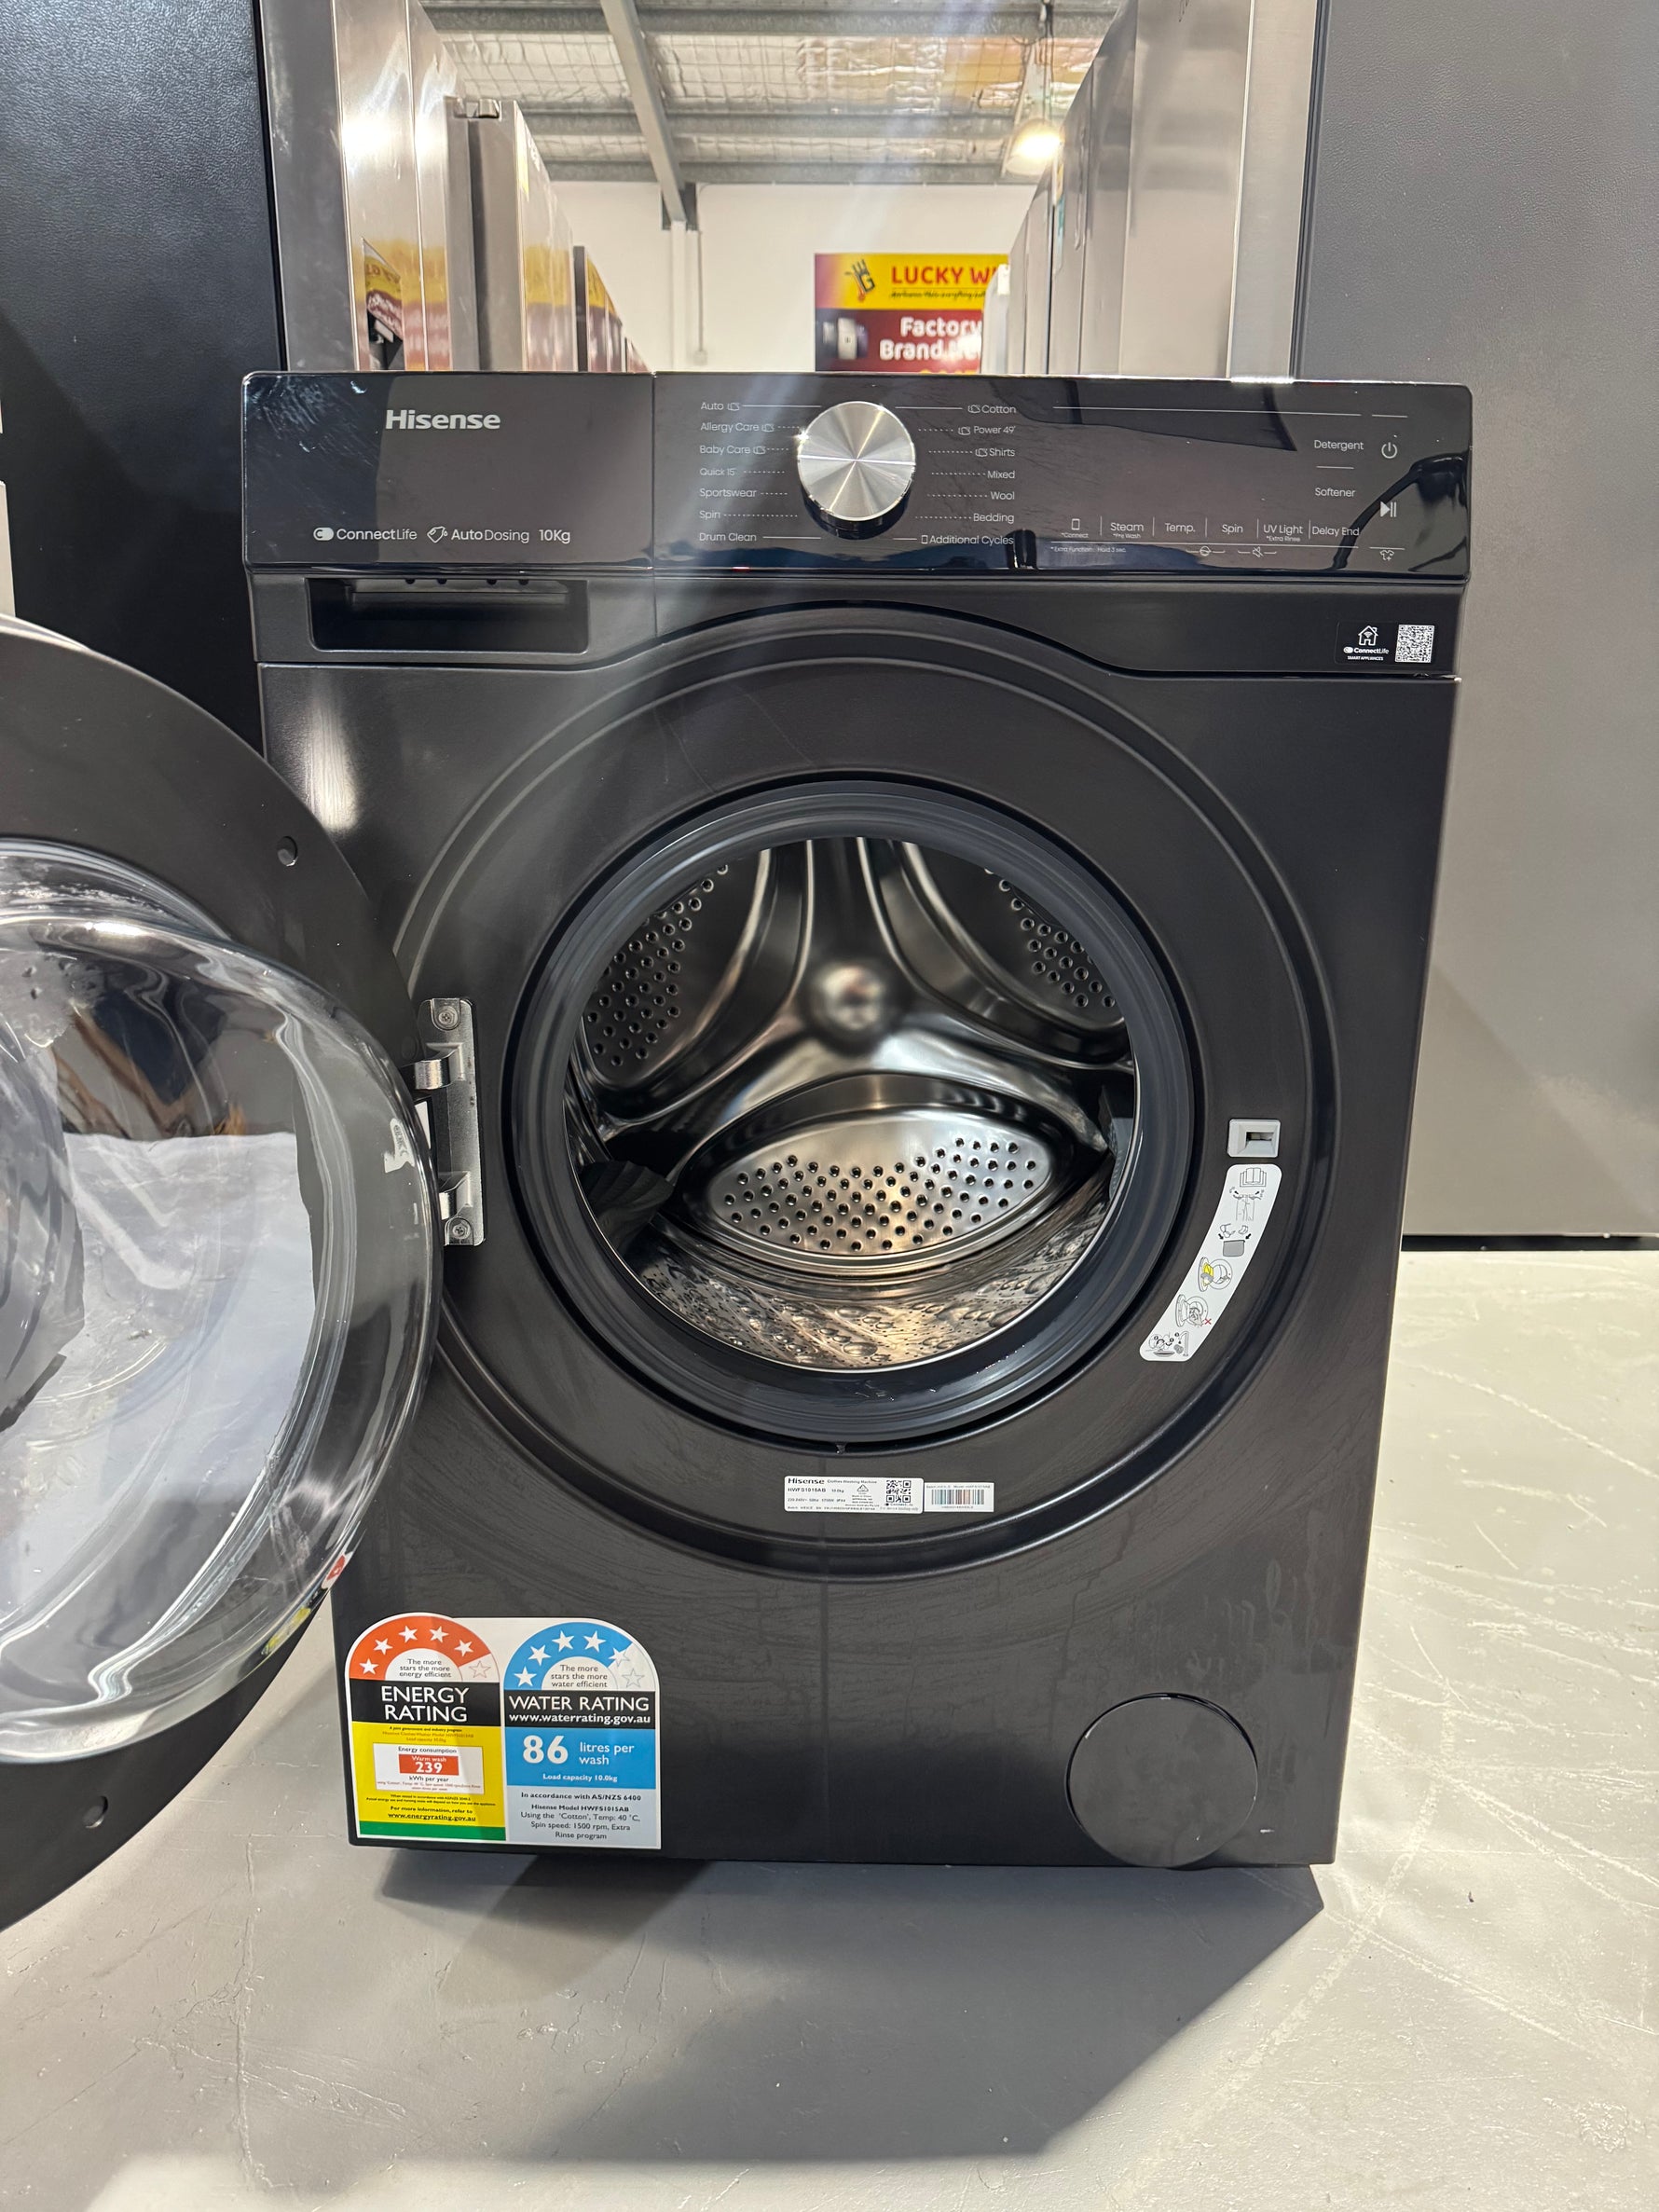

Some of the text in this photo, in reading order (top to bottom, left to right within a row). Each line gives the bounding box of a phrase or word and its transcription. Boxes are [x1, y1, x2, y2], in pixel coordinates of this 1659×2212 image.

[891, 266, 996, 284] LUCKY W
[879, 338, 943, 361] Brand
[701, 402, 724, 411] Auto
[981, 405, 1017, 414] Cotton
[385, 409, 501, 430] Hisense
[700, 422, 760, 433] Allergy Care
[973, 426, 1001, 434] Power
[700, 446, 751, 455] Baby Care
[1313, 439, 1364, 452] Detergent
[989, 448, 1016, 457] Shirts
[700, 468, 725, 476] Quick
[987, 470, 1016, 479] Mixed
[700, 488, 758, 499] Sportswear
[990, 491, 1015, 501] Wool
[1314, 488, 1356, 497] Softener
[700, 510, 721, 520] Spin
[973, 513, 1015, 524] Bedding
[1110, 522, 1145, 532] Steam
[1165, 522, 1196, 535] Temp.
[1221, 524, 1244, 534] Spin
[1263, 524, 1304, 536] UV Light
[1311, 526, 1361, 537] Delay End
[336, 528, 418, 542] ConnectLife
[538, 529, 571, 544] 10Kg
[699, 532, 758, 543] Drum Clean
[928, 535, 1014, 545] Additional Cycles
[560, 1664, 575, 1672] The
[380, 1685, 470, 1705] ENERGY
[508, 1696, 650, 1711] WATER RATING
[384, 1704, 468, 1723] RATING
[508, 1713, 651, 1725] www.waterrating.gov.au
[523, 1734, 569, 1765] 86
[580, 1741, 635, 1755] litres per
[579, 1754, 610, 1765] wash
[415, 1762, 443, 1774] 239
[562, 1774, 593, 1782] capacity
[594, 1774, 618, 1782] 10.0kg
[388, 1812, 476, 1822] www.energyrating.gov.au
[520, 1811, 542, 1820] Using
[593, 1813, 616, 1821] Temp:
[530, 1820, 546, 1829] Spin
[548, 1821, 571, 1830] speed:
[555, 1831, 575, 1839] Rinse
